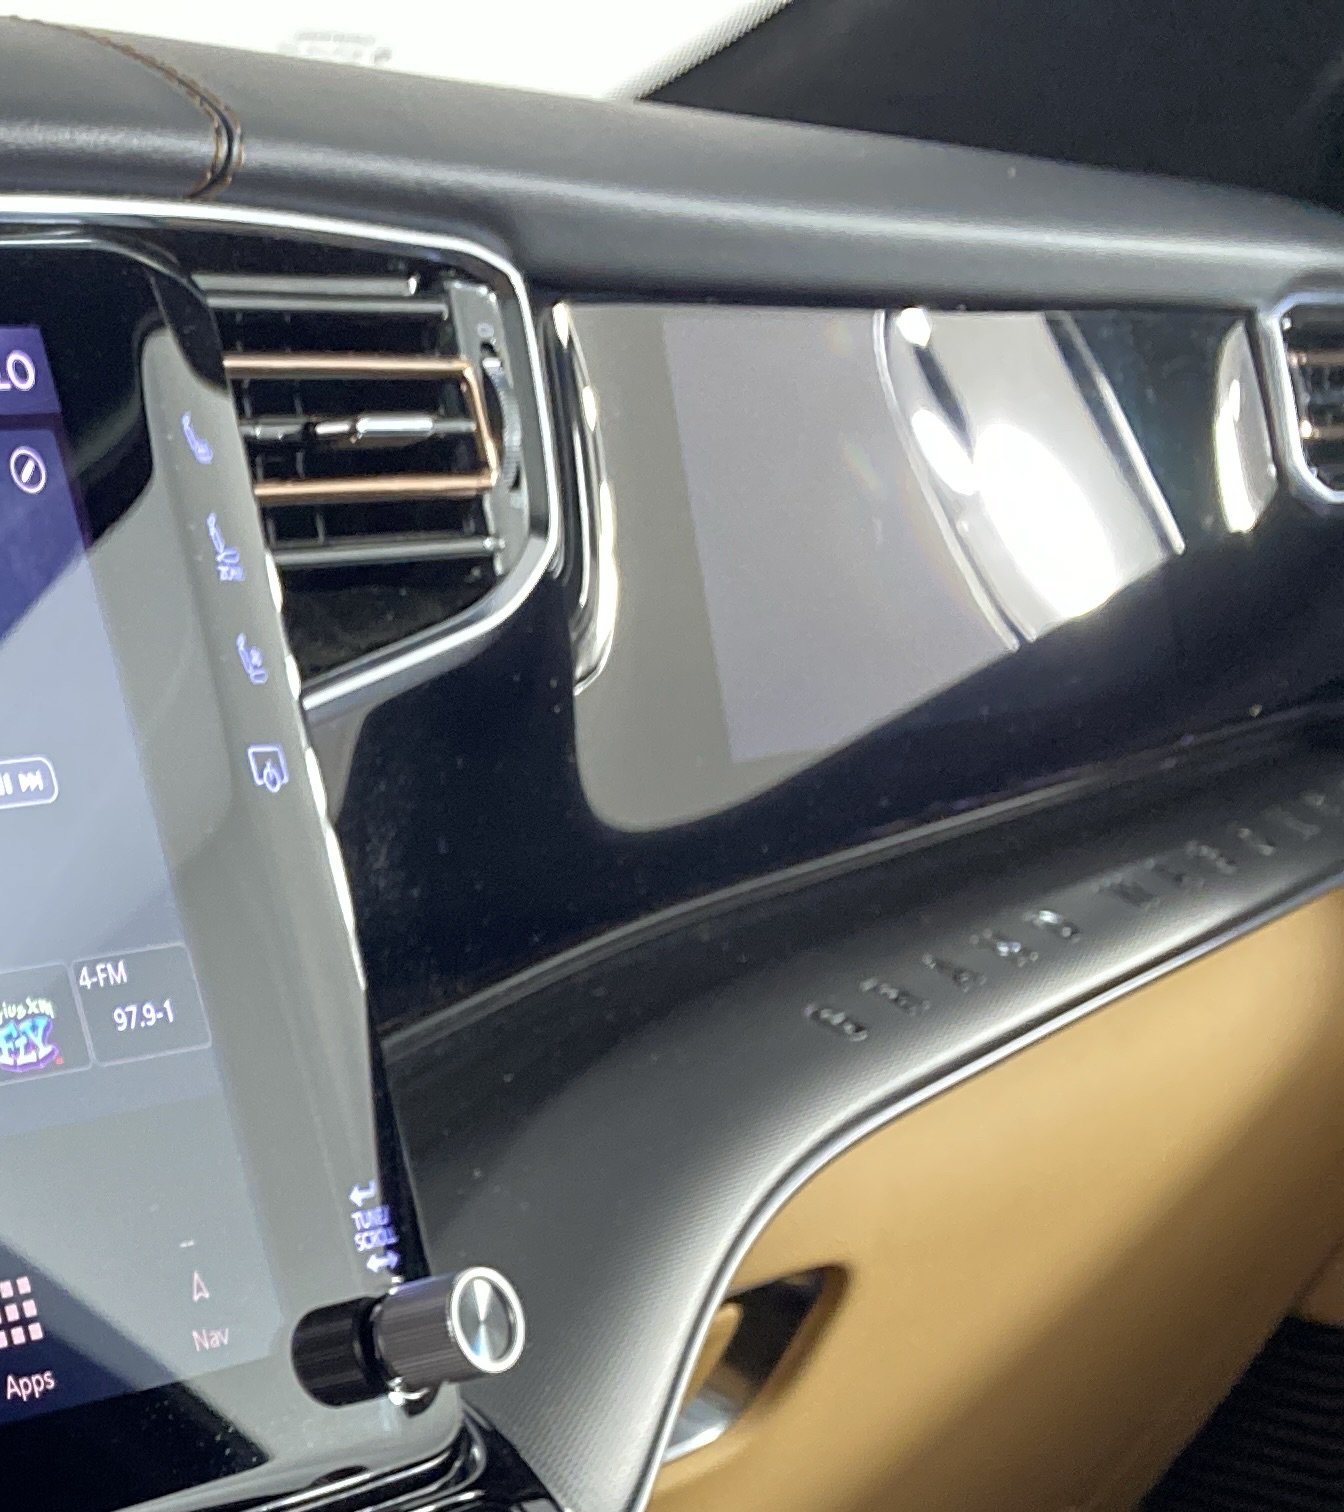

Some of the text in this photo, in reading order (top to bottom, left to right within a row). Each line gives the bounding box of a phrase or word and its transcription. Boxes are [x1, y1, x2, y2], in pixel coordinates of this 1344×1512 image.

[79, 961, 127, 989] 4-FM
[114, 999, 173, 1031] 97.9-1
[192, 1328, 229, 1351] Nav
[7, 1371, 55, 1401] Apps
